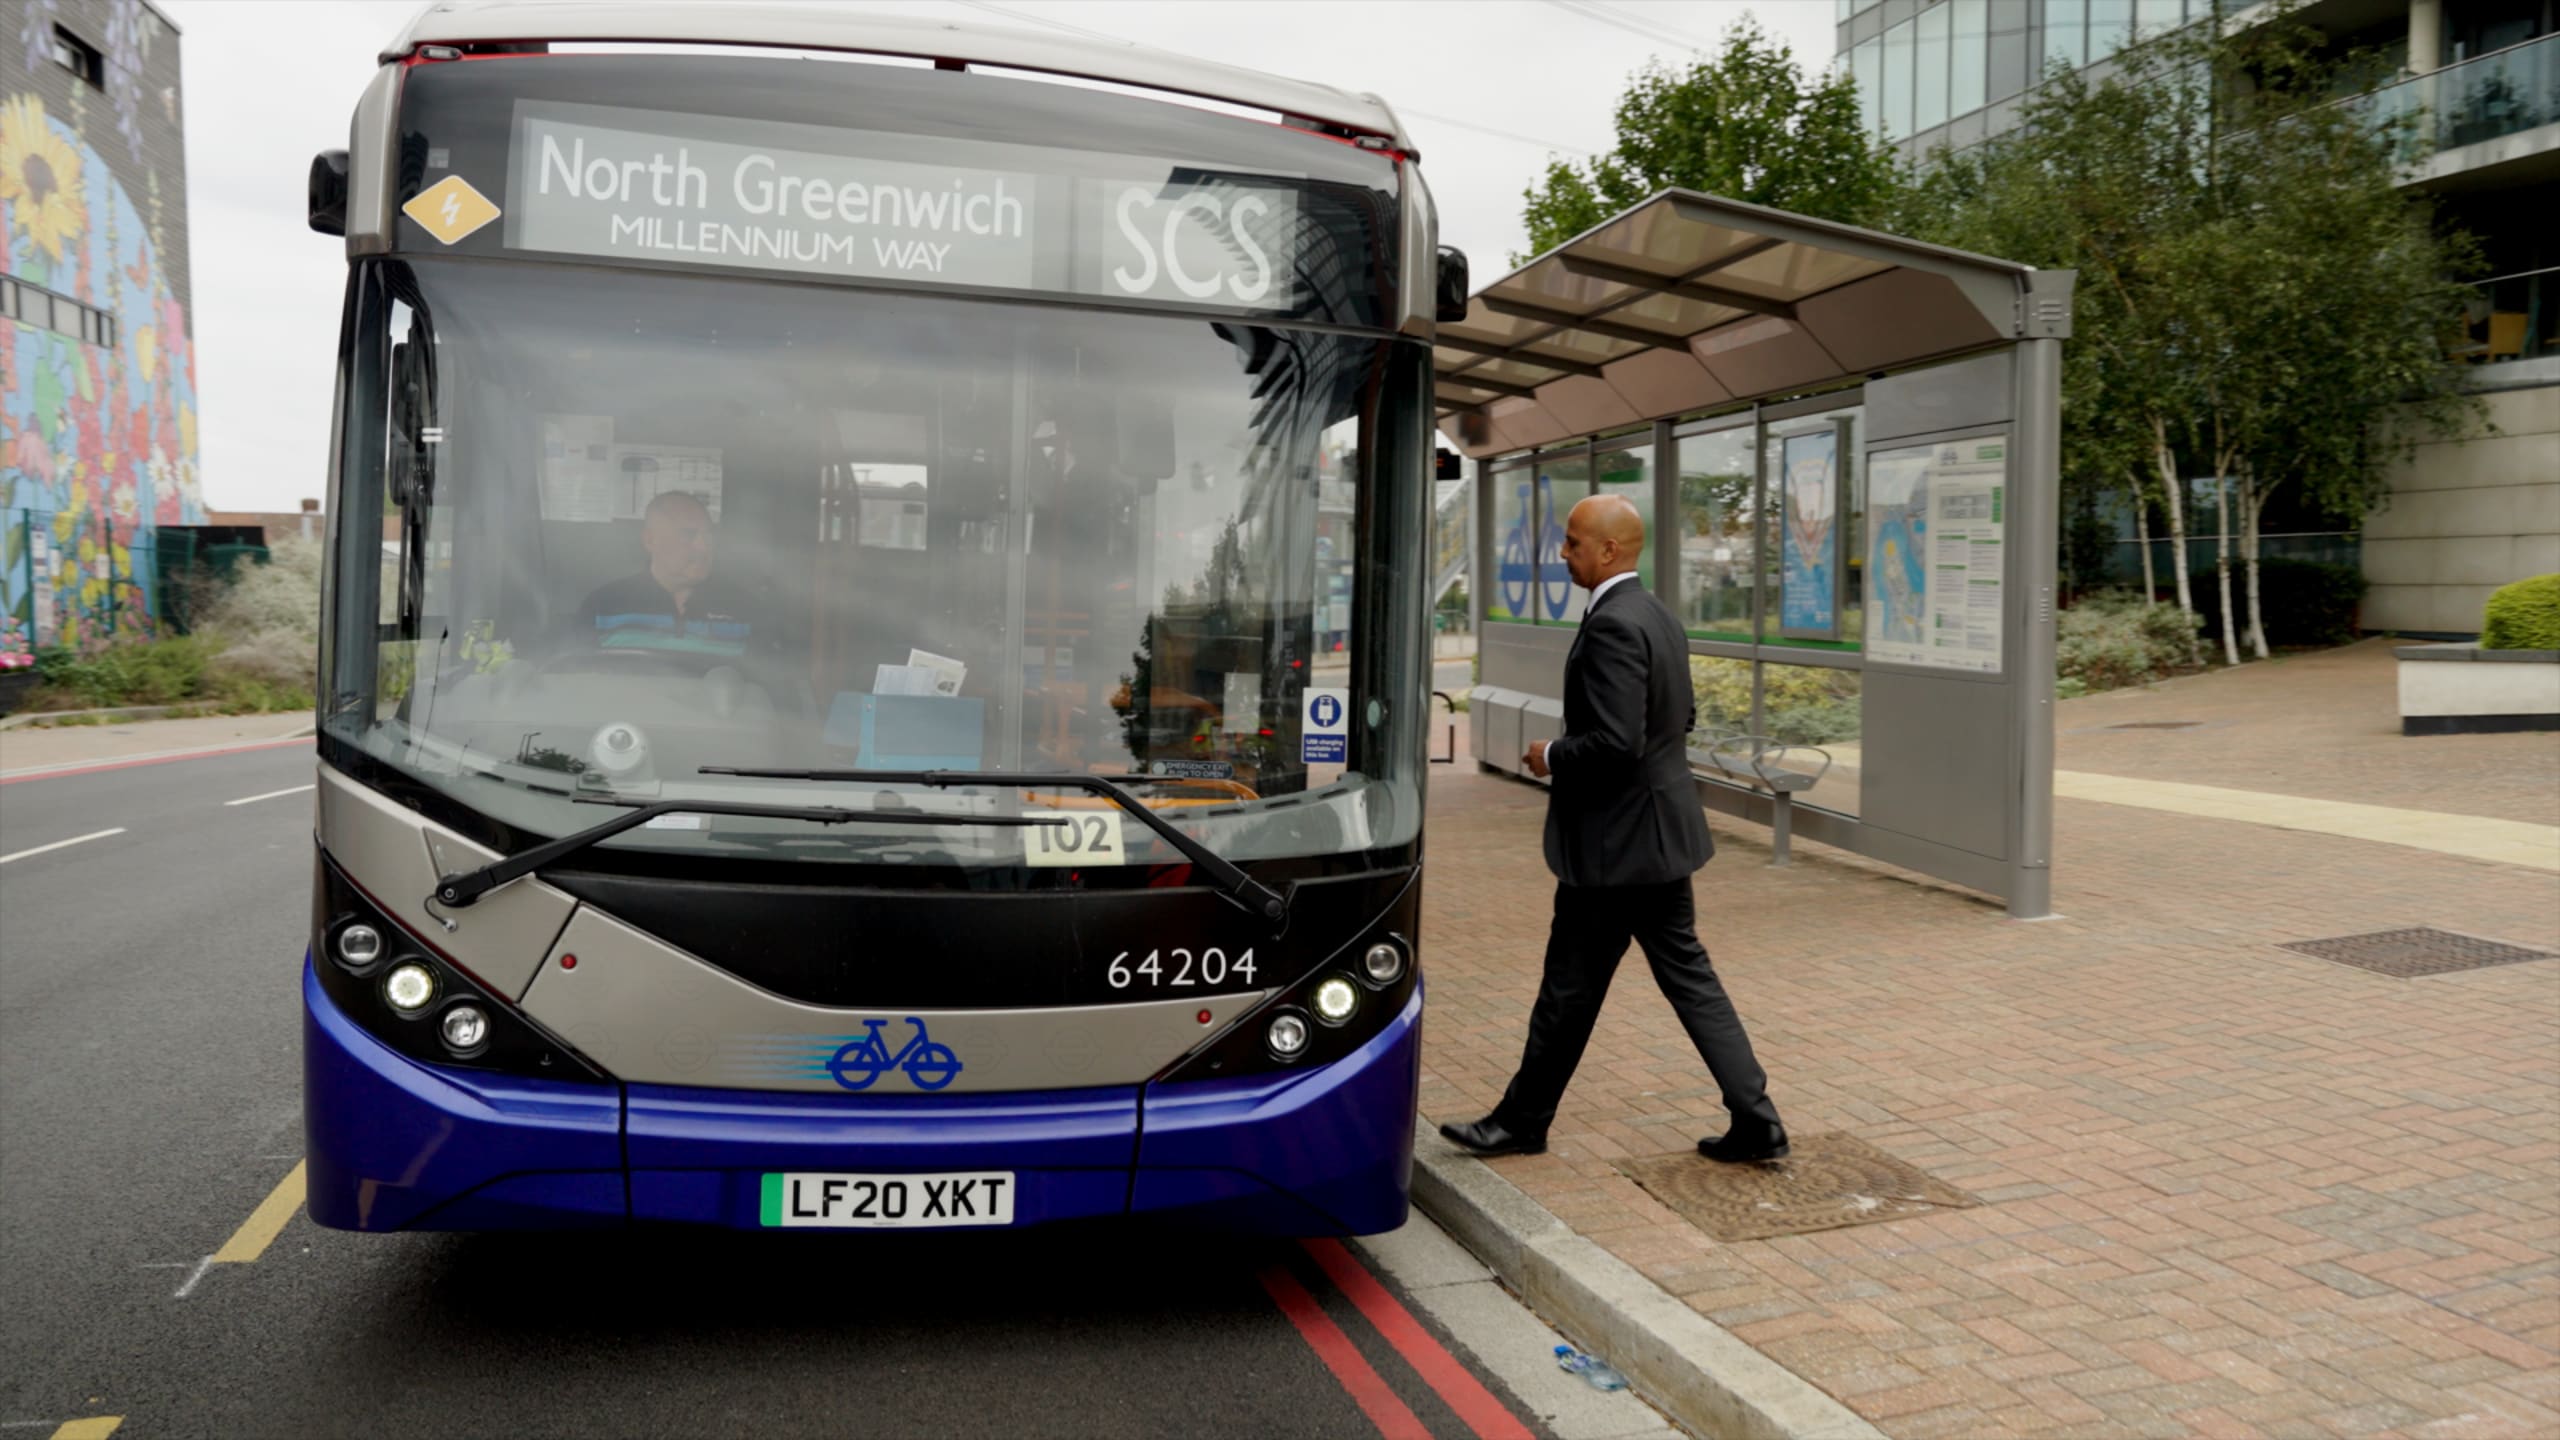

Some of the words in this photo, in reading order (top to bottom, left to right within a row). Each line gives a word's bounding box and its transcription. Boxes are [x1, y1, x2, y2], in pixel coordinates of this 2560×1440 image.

[540, 134, 707, 209] North
[733, 154, 1023, 238] Greenwich
[611, 213, 854, 266] MILLENNIUM
[872, 236, 952, 273] WAY
[1113, 187, 1271, 301] SCS
[1166, 762, 1211, 770] EMERGENCY
[1202, 770, 1225, 778] OPEN
[1040, 815, 1112, 853] 102
[1107, 947, 1258, 989] 64204
[792, 1179, 908, 1219] LF20
[922, 1178, 1006, 1218] XKT
